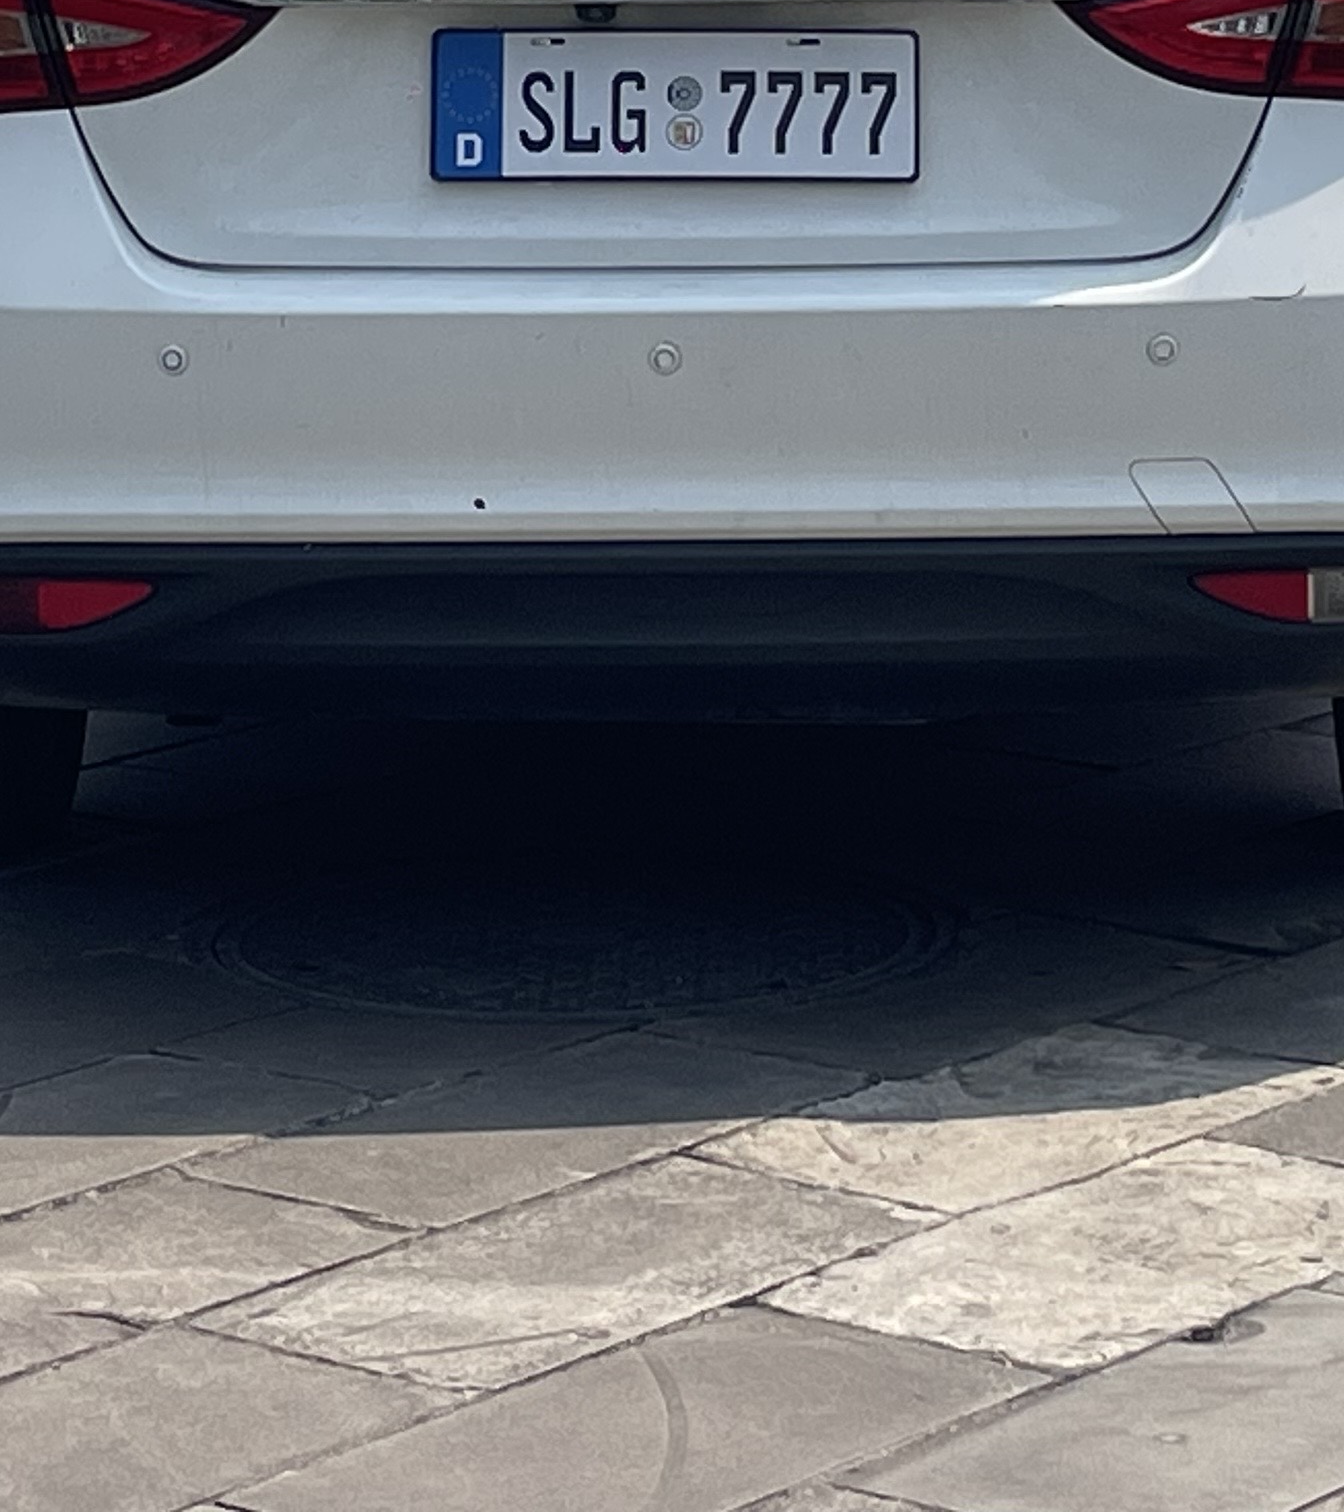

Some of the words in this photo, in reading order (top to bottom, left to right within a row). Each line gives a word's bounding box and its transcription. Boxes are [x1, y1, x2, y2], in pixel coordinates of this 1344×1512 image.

[518, 70, 647, 154] SLG
[720, 70, 897, 156] 7777
[455, 132, 484, 168] D
